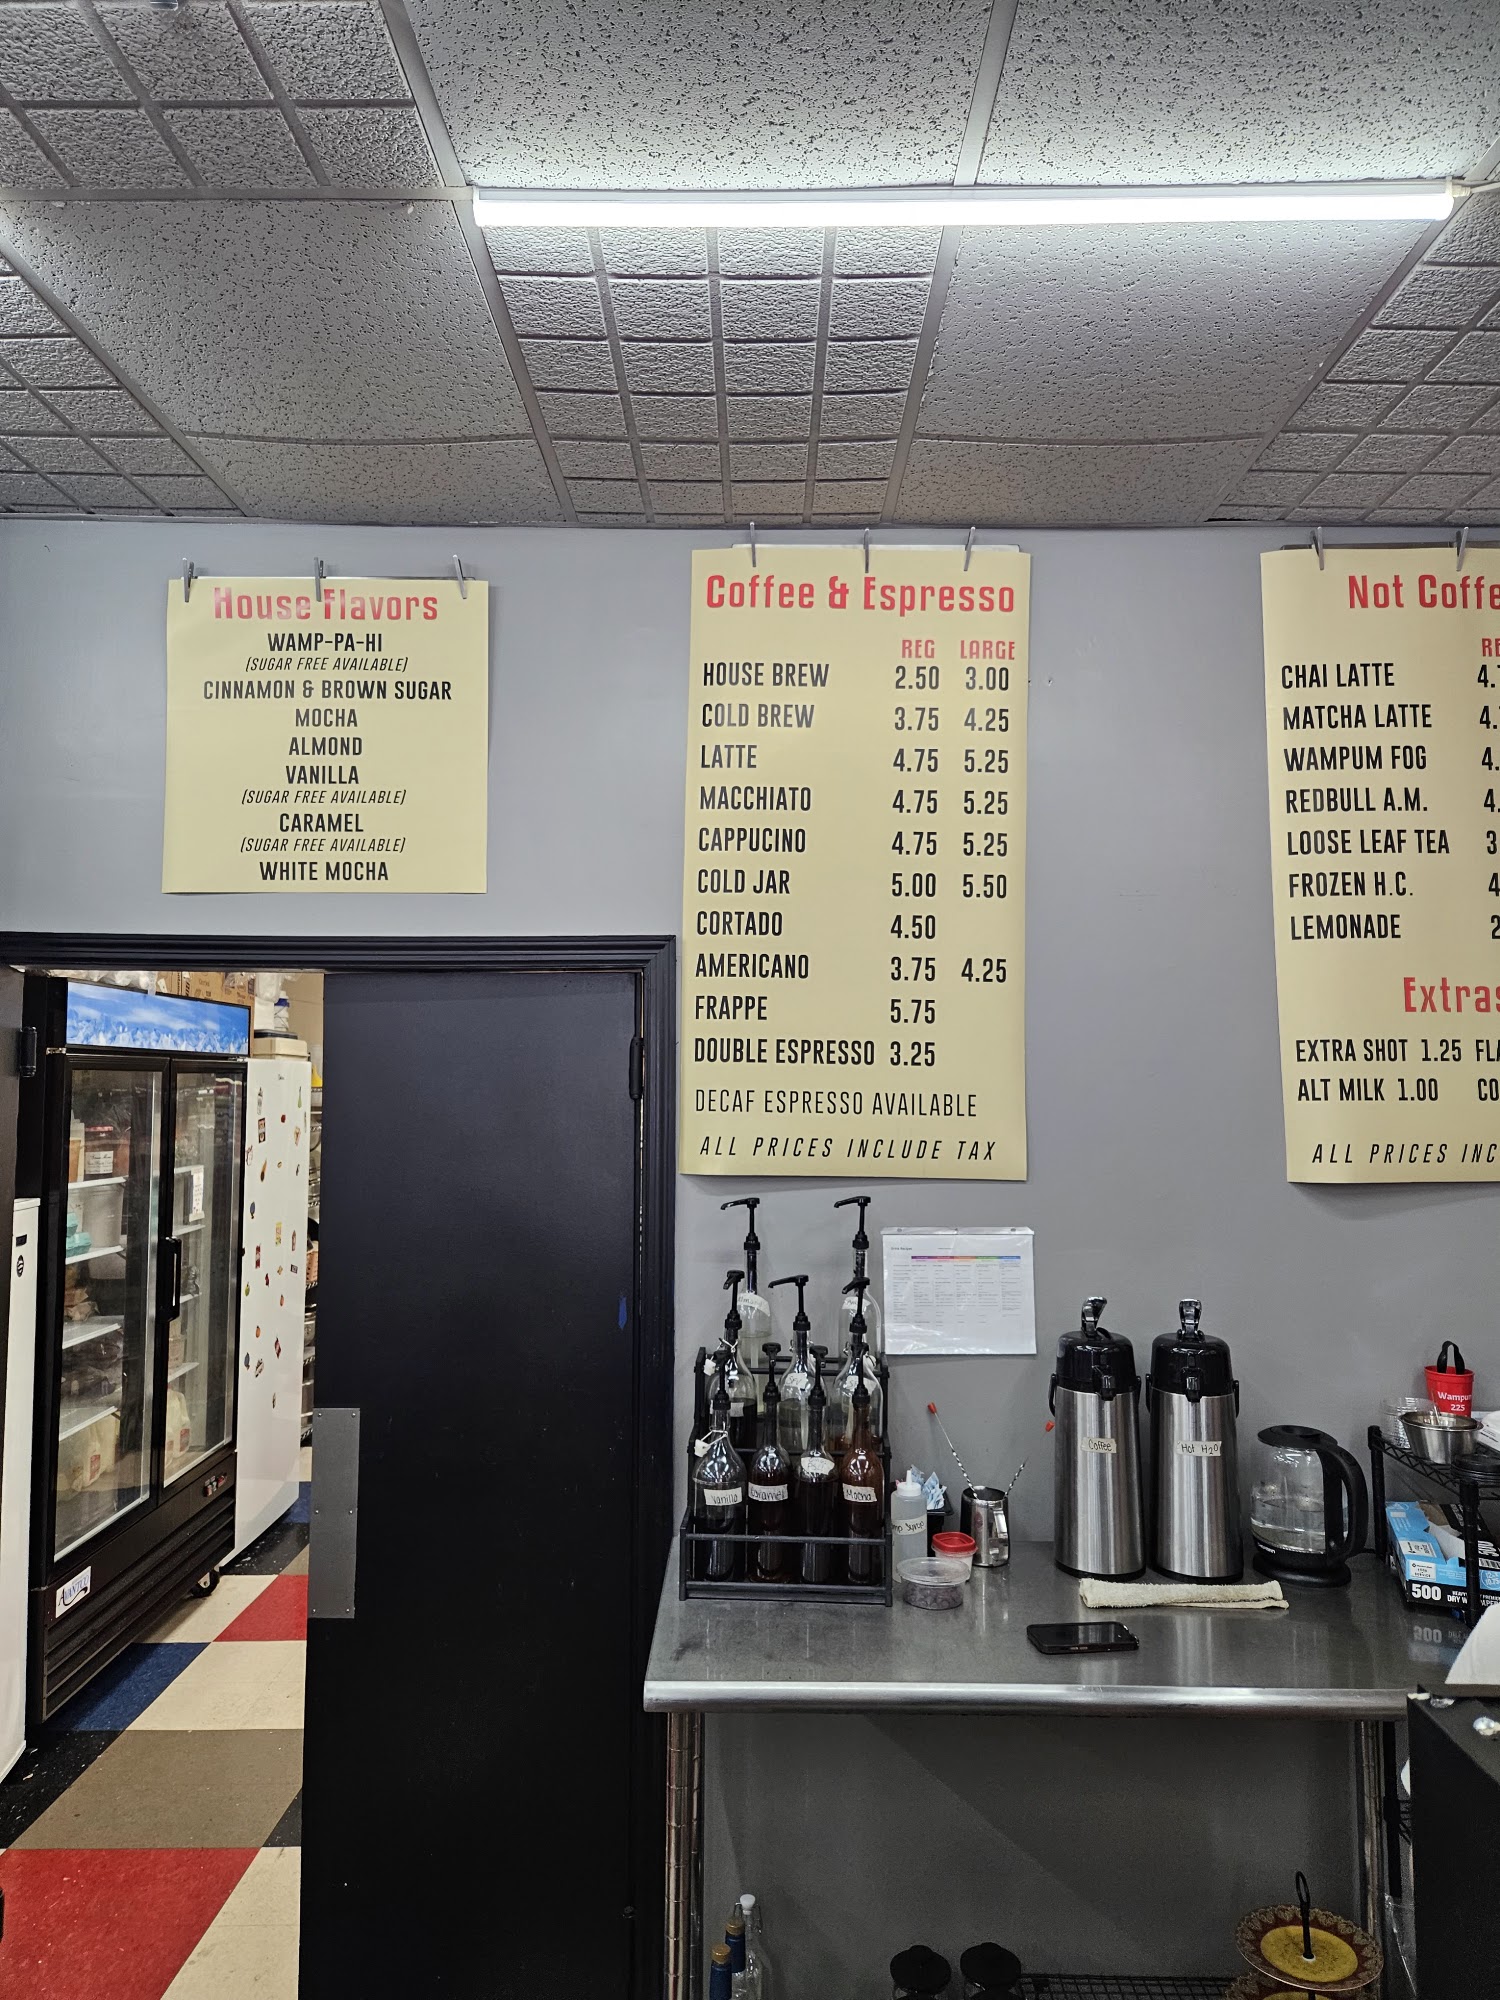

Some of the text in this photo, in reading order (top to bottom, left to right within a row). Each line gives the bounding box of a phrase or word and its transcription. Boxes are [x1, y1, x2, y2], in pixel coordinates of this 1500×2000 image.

[215, 588, 437, 620] House Flavors
[707, 575, 1014, 617] Coffee & Espresso
[1349, 575, 1404, 608] Not
[268, 633, 381, 652] WAMP-PA-HI
[902, 640, 1015, 660] REG LARGE
[246, 657, 408, 672] (SUGAR FREE AVAILABLE)
[704, 662, 1008, 691] HOUSE BREW 2.50 3.00
[1282, 664, 1327, 689] CHAI
[1337, 663, 1394, 687] LATTE
[204, 680, 451, 700] CINNAMON & BROWN SUGAR
[296, 709, 357, 727] MOCHA
[702, 703, 1008, 732] COLD BREW 3.75 4.25
[1283, 705, 1366, 730] MATCHA
[1375, 704, 1432, 727] LATTE
[289, 737, 362, 755] ALMOND
[1284, 746, 1382, 771] WAMPUM
[1391, 746, 1426, 769] FOG
[701, 745, 1008, 773] LATTE 4.75 5.25
[286, 766, 359, 784] VANILLA
[242, 789, 406, 805] (SUGAR FREE AVAILABLE)
[700, 786, 1008, 815] MACCHIATO 4.75 5.25
[1286, 788, 1376, 813] REDBULL
[1384, 787, 1427, 811] A.M.
[280, 813, 363, 832] CARAMEL
[241, 837, 405, 853] (SUGAR FREE AVAILABLE)
[699, 828, 1007, 857] CAPPUCINO 4.75 5.25
[1288, 830, 1351, 855] LOOSE
[1360, 830, 1406, 853] LEAF
[1414, 830, 1449, 853] TEA
[260, 862, 388, 880] WHITE MOCHA
[698, 869, 1006, 898] COLD JAR 5.00 5.50
[1289, 872, 1365, 897] FROZEN
[1374, 872, 1413, 896] H.C.
[697, 911, 935, 939] CORTADO 4.50
[1291, 914, 1401, 940] LEMONADE
[696, 953, 1006, 983] AMERICANO 3.75 4.25
[696, 996, 935, 1024] FRAPPE 5.75
[695, 1038, 935, 1066] DOUBLE ESPRESSO 3.25
[1296, 1039, 1356, 1062] EXTRA
[1364, 1039, 1408, 1061] SHOT
[1421, 1039, 1461, 1062] 1.25
[1298, 1079, 1330, 1101] ALT
[1339, 1078, 1384, 1101] MILK
[1398, 1078, 1438, 1101] 1.00
[696, 1090, 976, 1116] DECAF ESPRESSO AVAILABLE
[700, 1136, 995, 1160] ALL PRICES INCLUDE TAX
[1312, 1144, 1352, 1163] ALL
[1370, 1144, 1447, 1163] PRICES
[1450, 1403, 1466, 1412] 225
[1088, 1438, 1112, 1452] Coffee
[1181, 1443, 1195, 1454] Hot
[711, 1493, 738, 1504] Vanilla
[1411, 1583, 1442, 1601] 500
